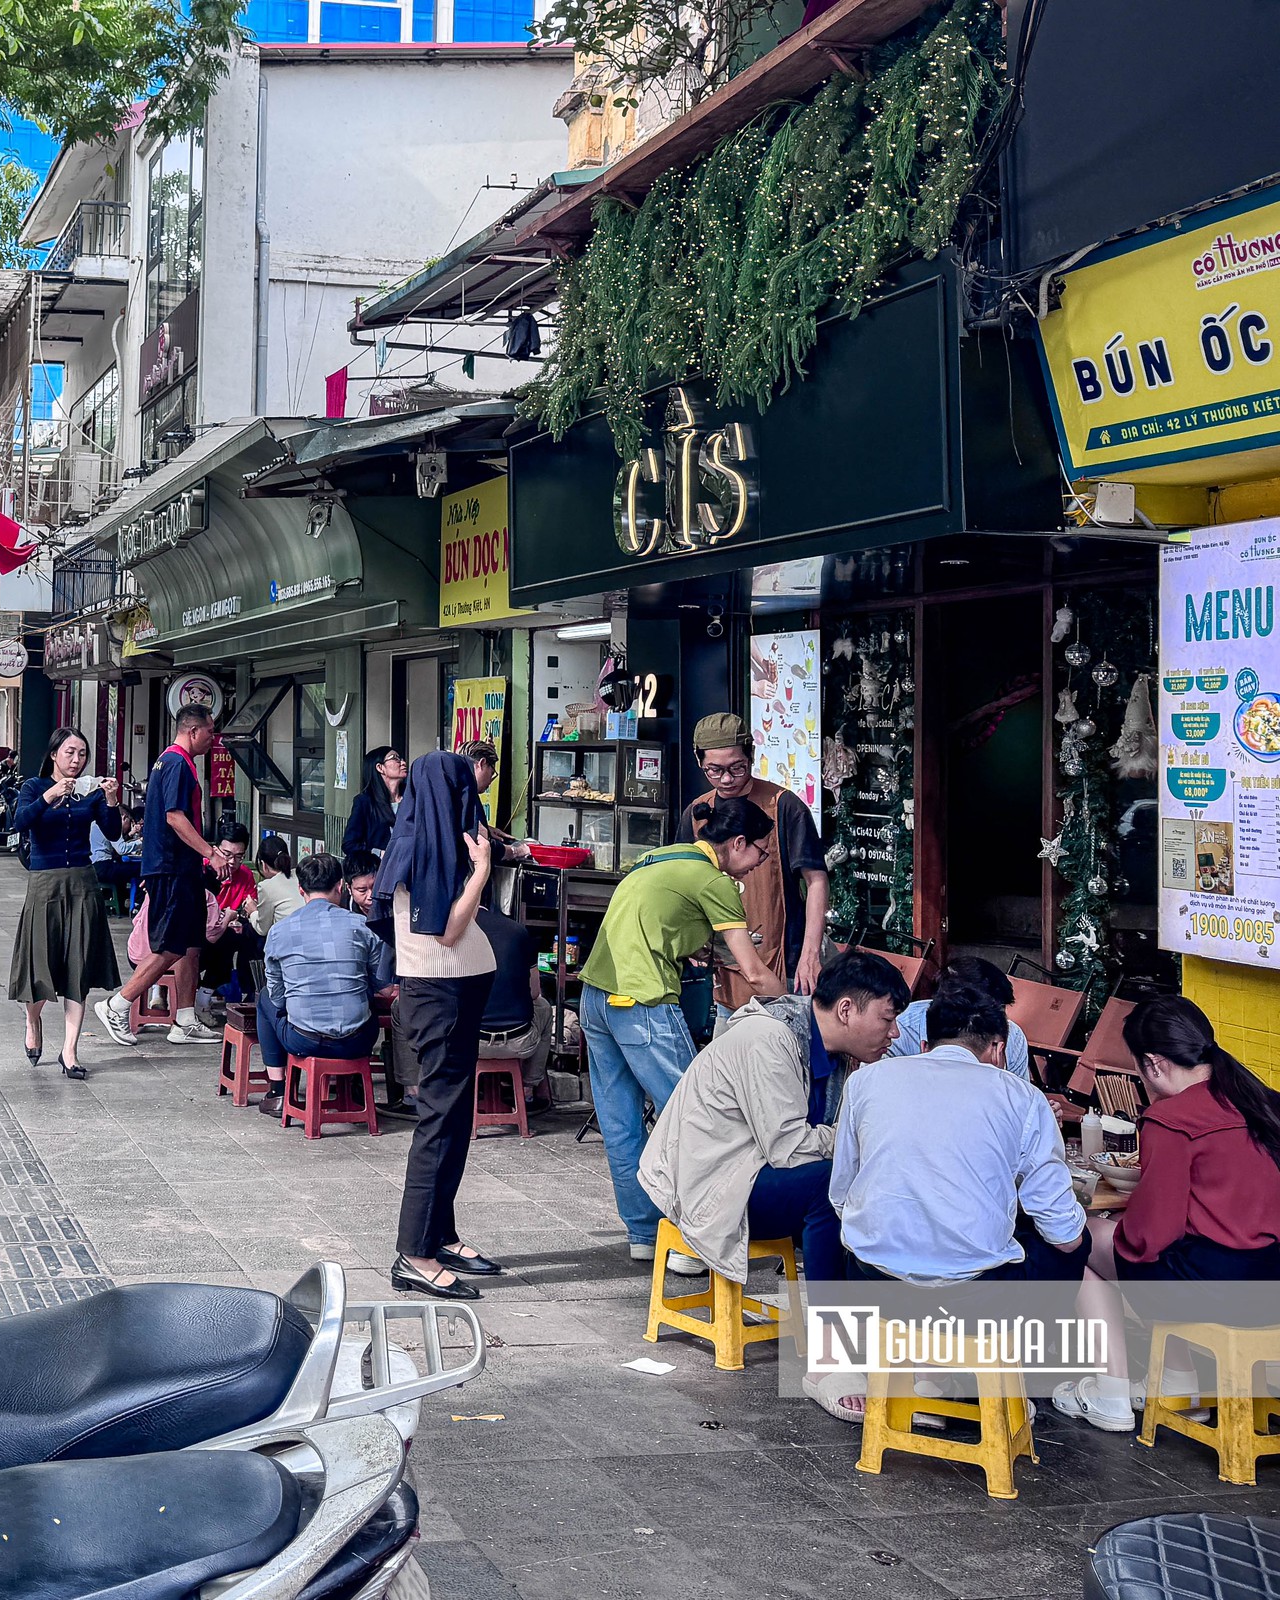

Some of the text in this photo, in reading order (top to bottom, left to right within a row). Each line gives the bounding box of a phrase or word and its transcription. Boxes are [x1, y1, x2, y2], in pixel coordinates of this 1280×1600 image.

[1193, 253, 1215, 275] CÔ
[1073, 306, 1270, 401] BÚN ỐC
[1121, 396, 1280, 441] ĐỊA CHỈ: 42 LÝ THƯỜNG KIỆT
[445, 528, 470, 584] BÚN
[473, 530, 499, 588] DỌC
[484, 597, 490, 610] HN
[1185, 585, 1273, 642] MENU
[1240, 674, 1256, 695] BÁN CHẠY
[857, 744, 882, 753] OPENIN
[219, 765, 235, 778] TÁ
[217, 781, 232, 794] LĂ
[857, 827, 872, 836] Cis42
[867, 873, 878, 882] you
[879, 872, 888, 882] for
[1190, 912, 1275, 945] 1900.9085
